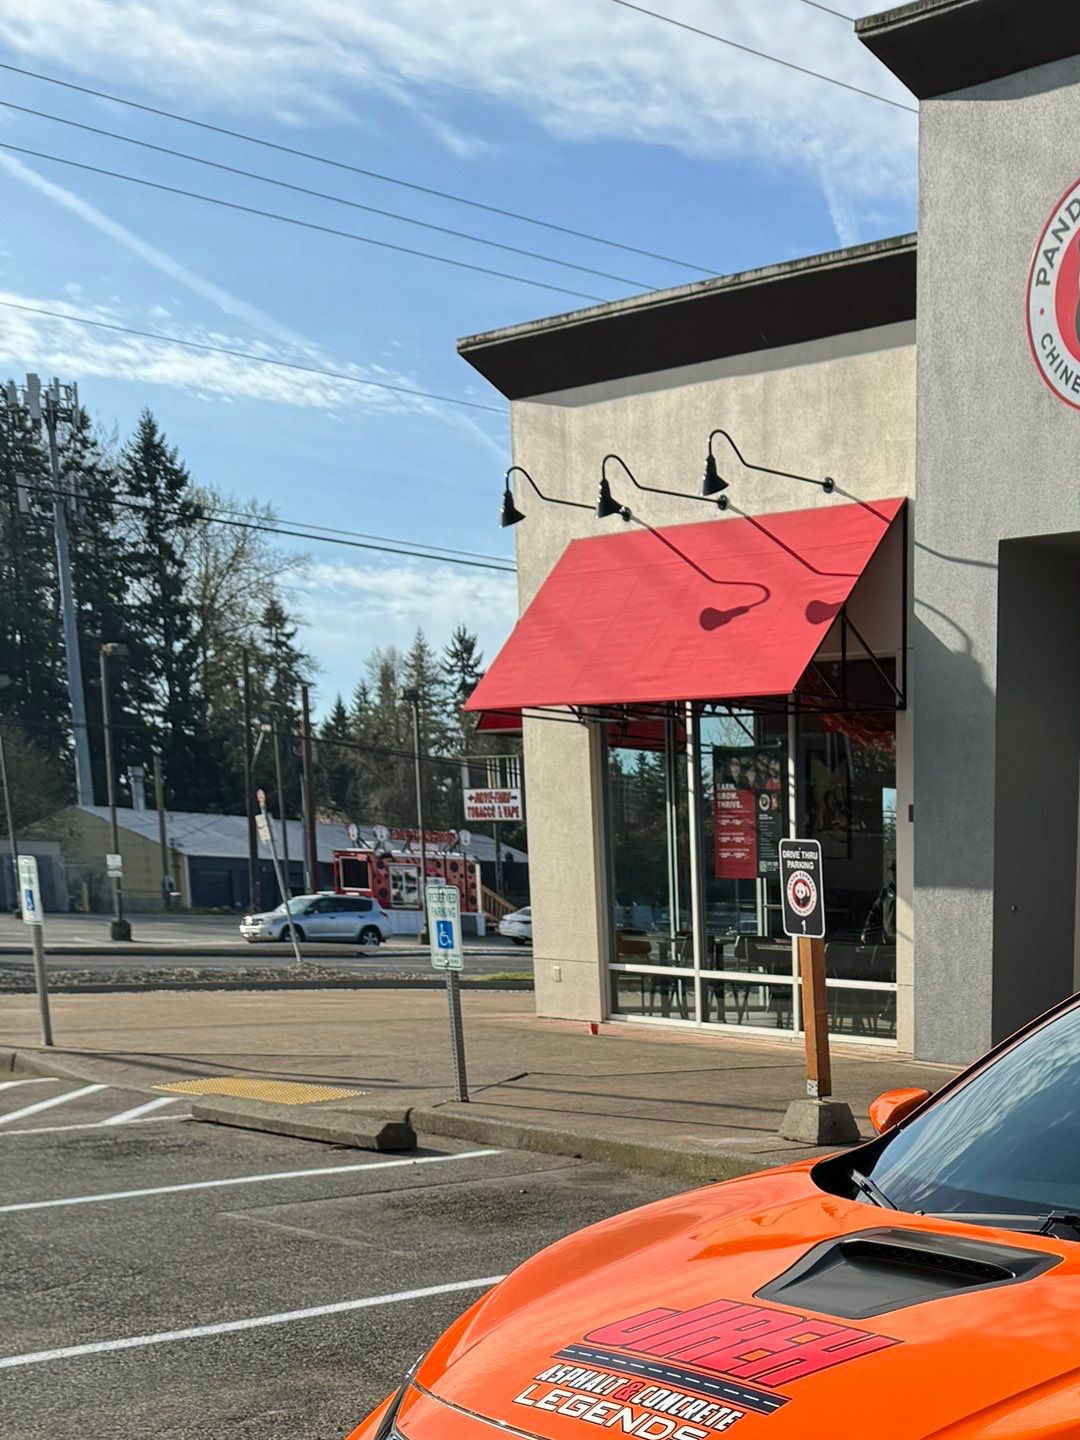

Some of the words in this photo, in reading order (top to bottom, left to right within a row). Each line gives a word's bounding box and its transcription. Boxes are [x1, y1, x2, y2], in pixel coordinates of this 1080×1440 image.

[717, 800, 743, 809] THRIVE.
[782, 850, 801, 859] DRIVE
[801, 851, 818, 860] THRU
[786, 860, 814, 870] PARKING
[583, 1298, 905, 1388] JIREH
[532, 1363, 627, 1397] ASPHALT
[612, 1381, 645, 1401] &
[631, 1385, 746, 1432] CONCRETE
